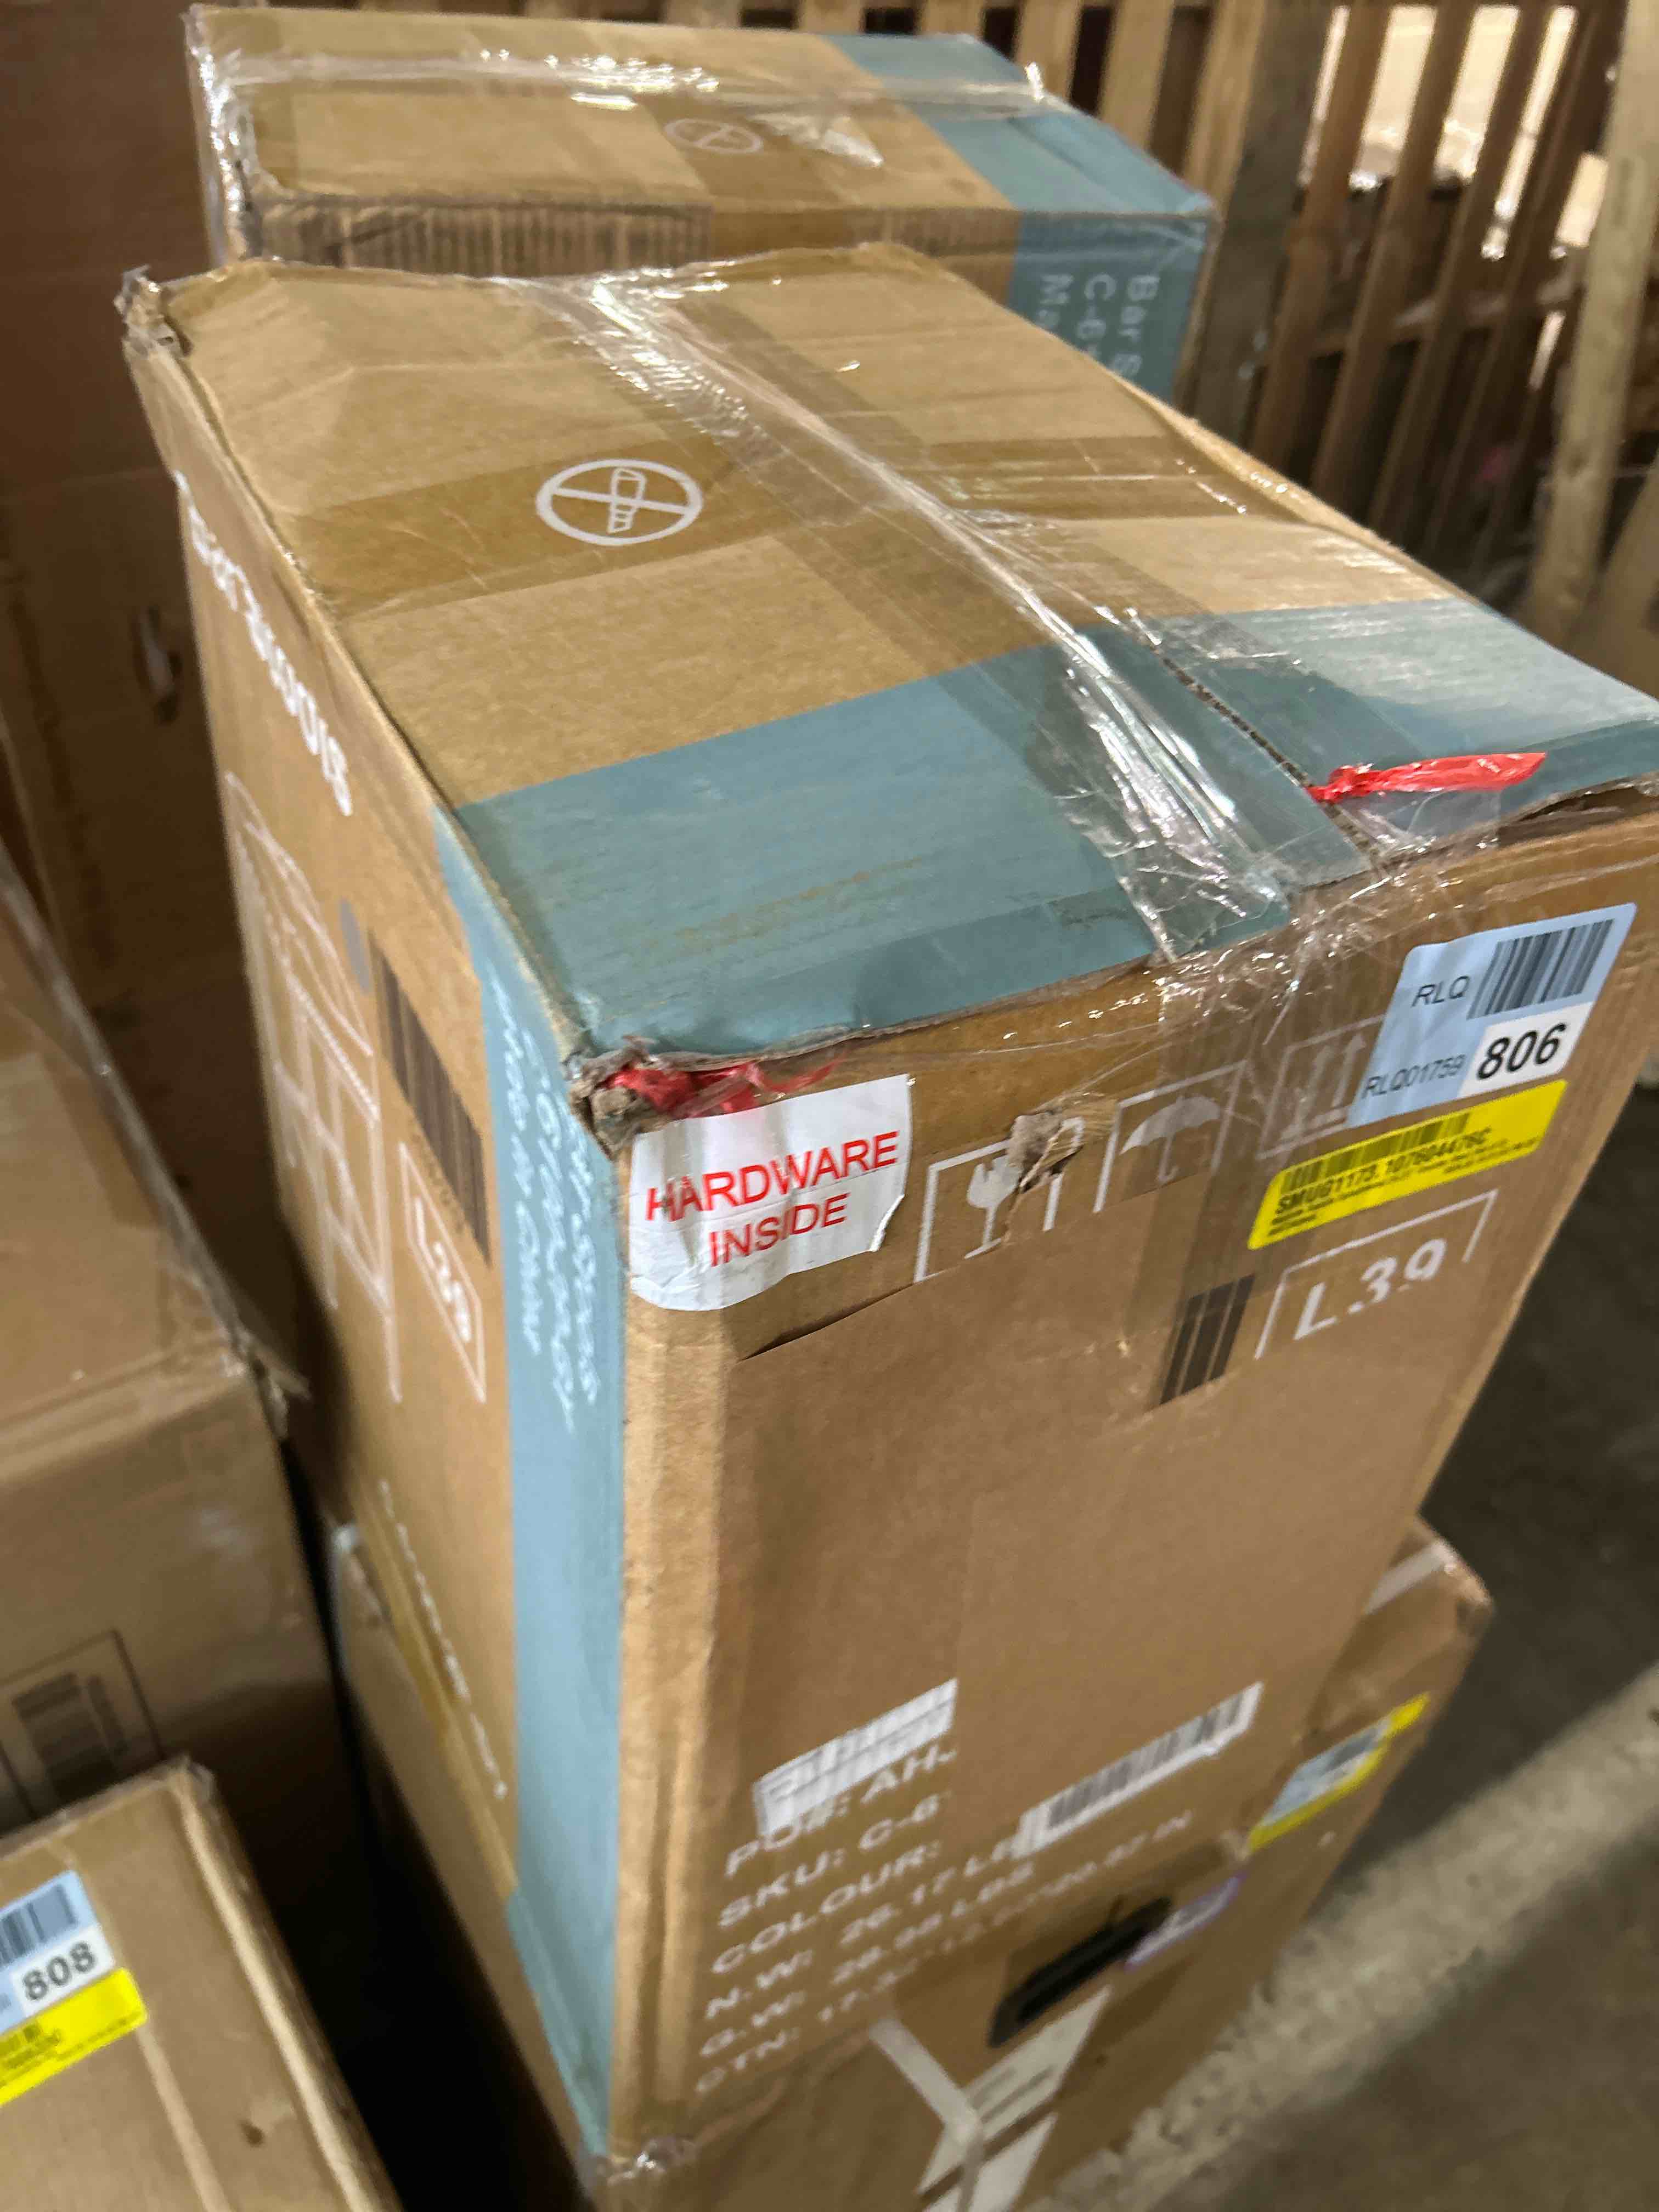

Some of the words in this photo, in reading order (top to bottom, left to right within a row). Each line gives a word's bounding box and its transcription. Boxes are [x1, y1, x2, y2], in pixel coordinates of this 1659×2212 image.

[1412, 975, 1470, 1007] RLQ
[1476, 1022, 1567, 1080] 806
[645, 1130, 899, 1222] HARDWARE
[708, 1192, 851, 1267] INSIDE
[712, 1839, 941, 1974] COLOUR:
[719, 1848, 845, 1927] SKU:
[24, 1942, 95, 2001] 808
